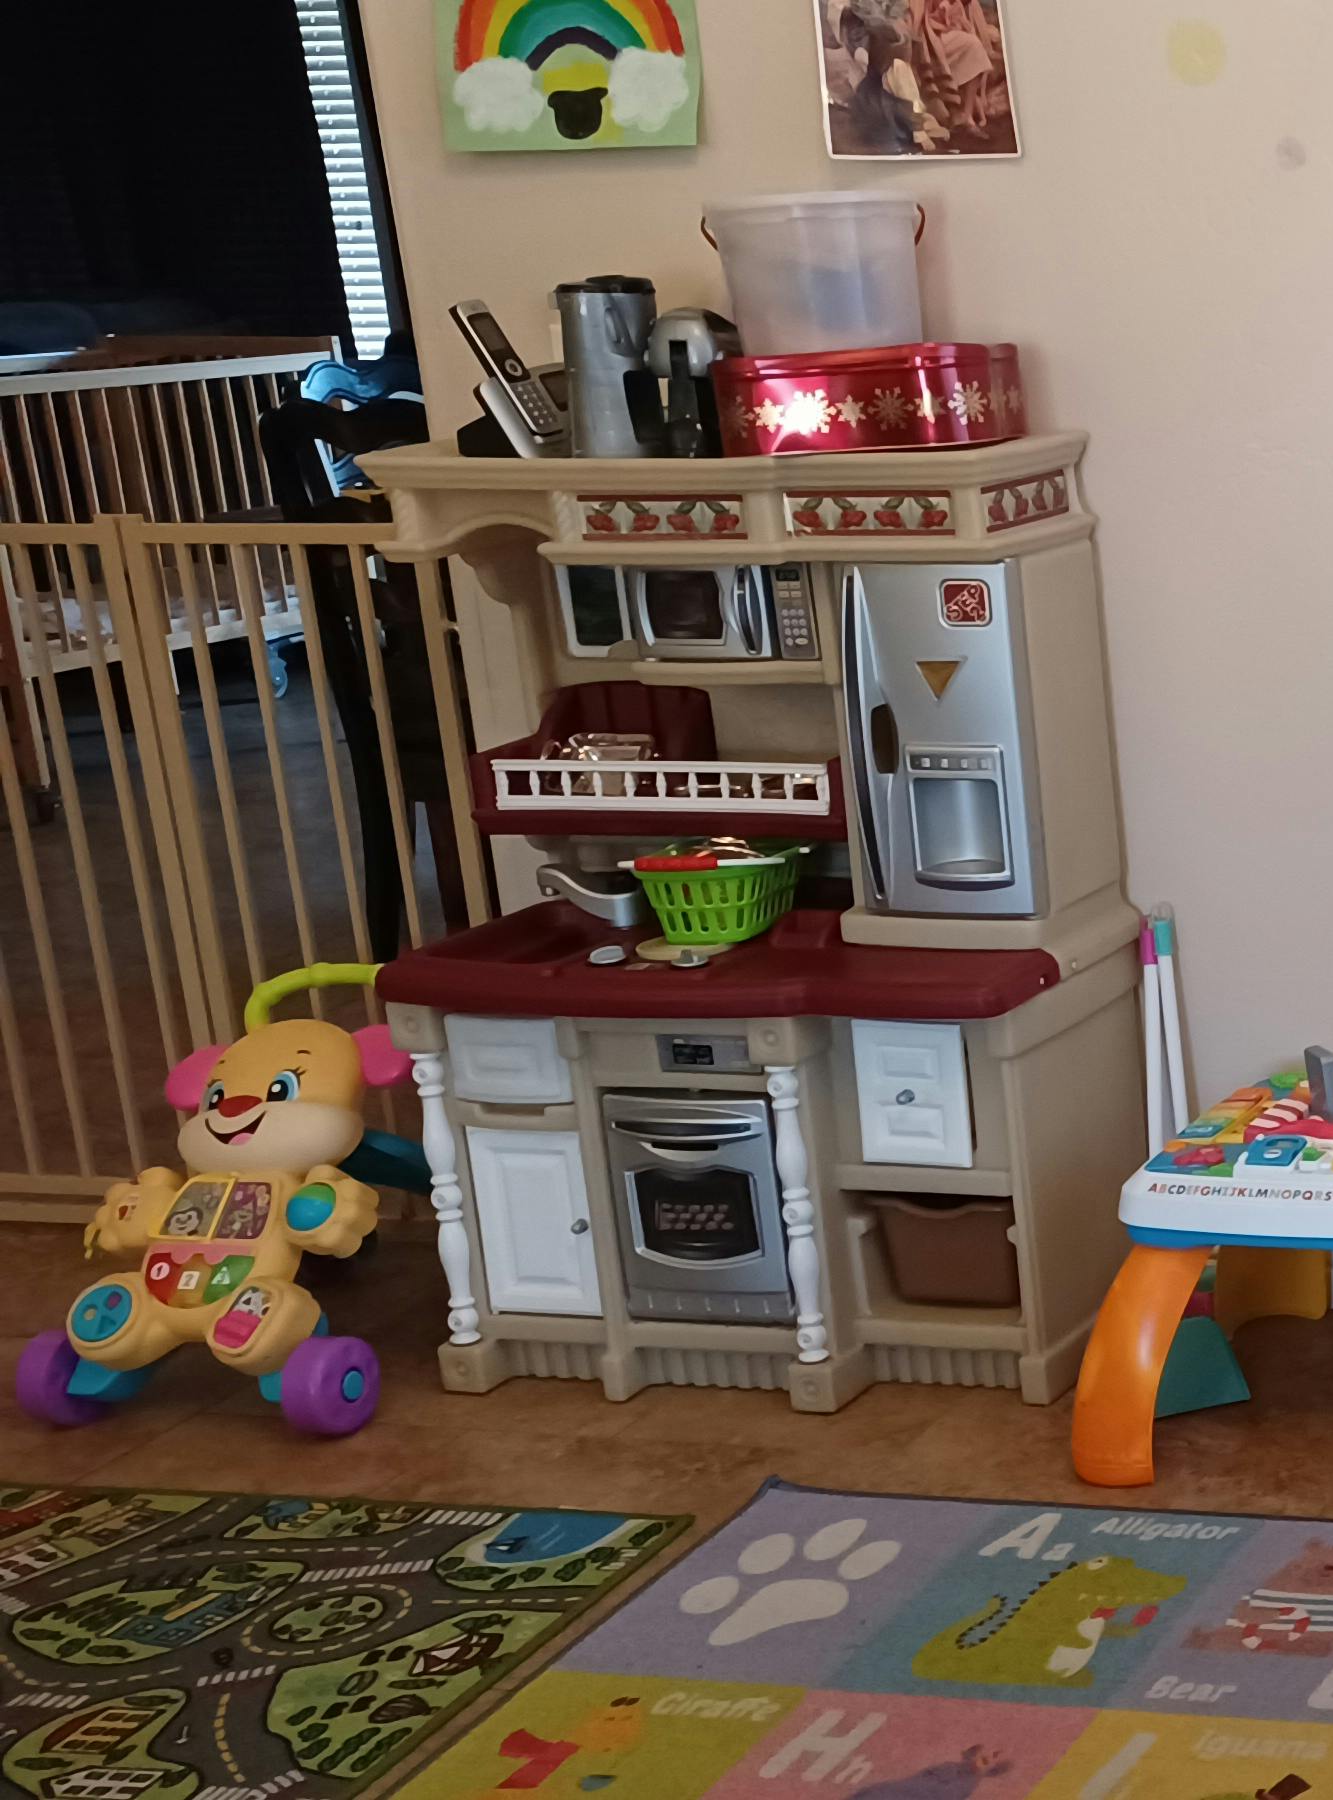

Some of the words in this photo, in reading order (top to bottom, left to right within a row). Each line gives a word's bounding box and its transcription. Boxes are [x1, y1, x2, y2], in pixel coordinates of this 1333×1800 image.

[156, 1265, 164, 1277] 1
[182, 1274, 193, 1287] 2
[979, 1513, 1076, 1561] Aa
[1092, 1517, 1240, 1542] Alligator
[1145, 1676, 1238, 1703] Bear
[651, 1692, 781, 1722] Giraffe
[760, 1710, 886, 1784] Hh
